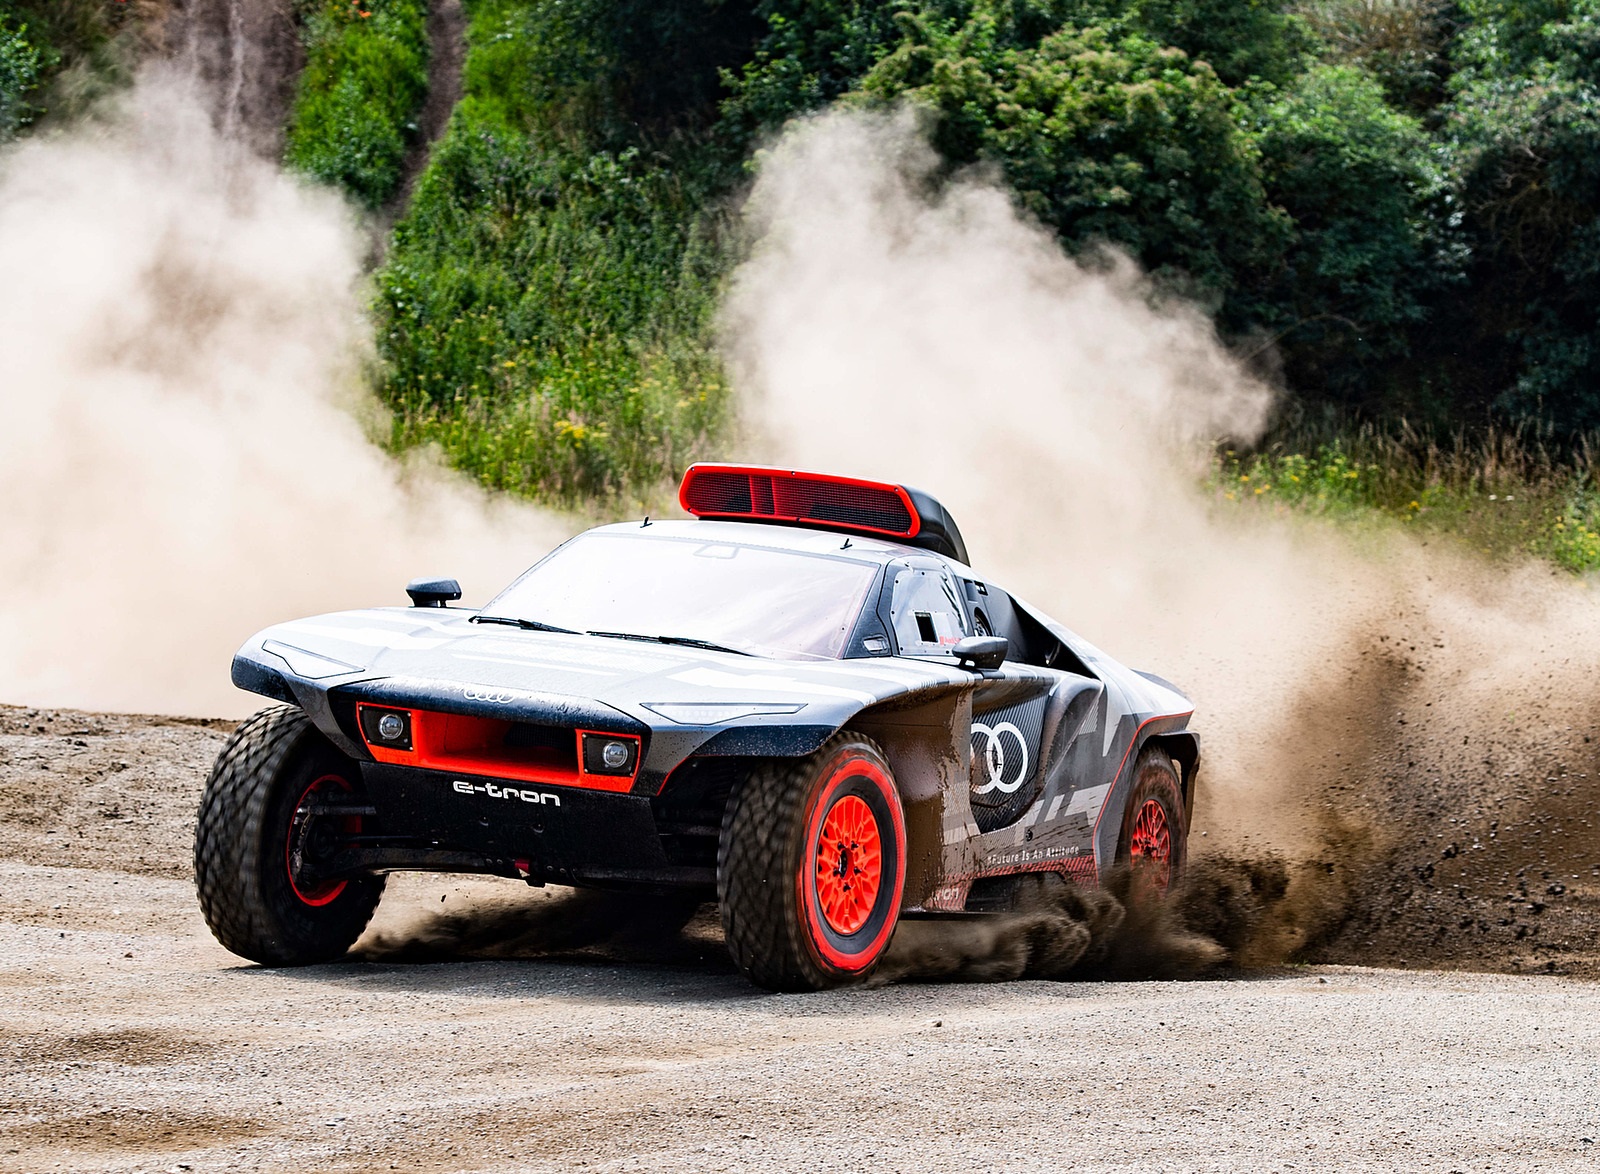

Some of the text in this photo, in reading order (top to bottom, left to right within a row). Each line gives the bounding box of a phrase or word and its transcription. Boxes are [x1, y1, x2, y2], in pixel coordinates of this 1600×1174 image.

[453, 781, 561, 807] e-tron
[1022, 850, 1030, 861] Is
[1032, 849, 1044, 860] An
[1046, 846, 1079, 858] Attitude
